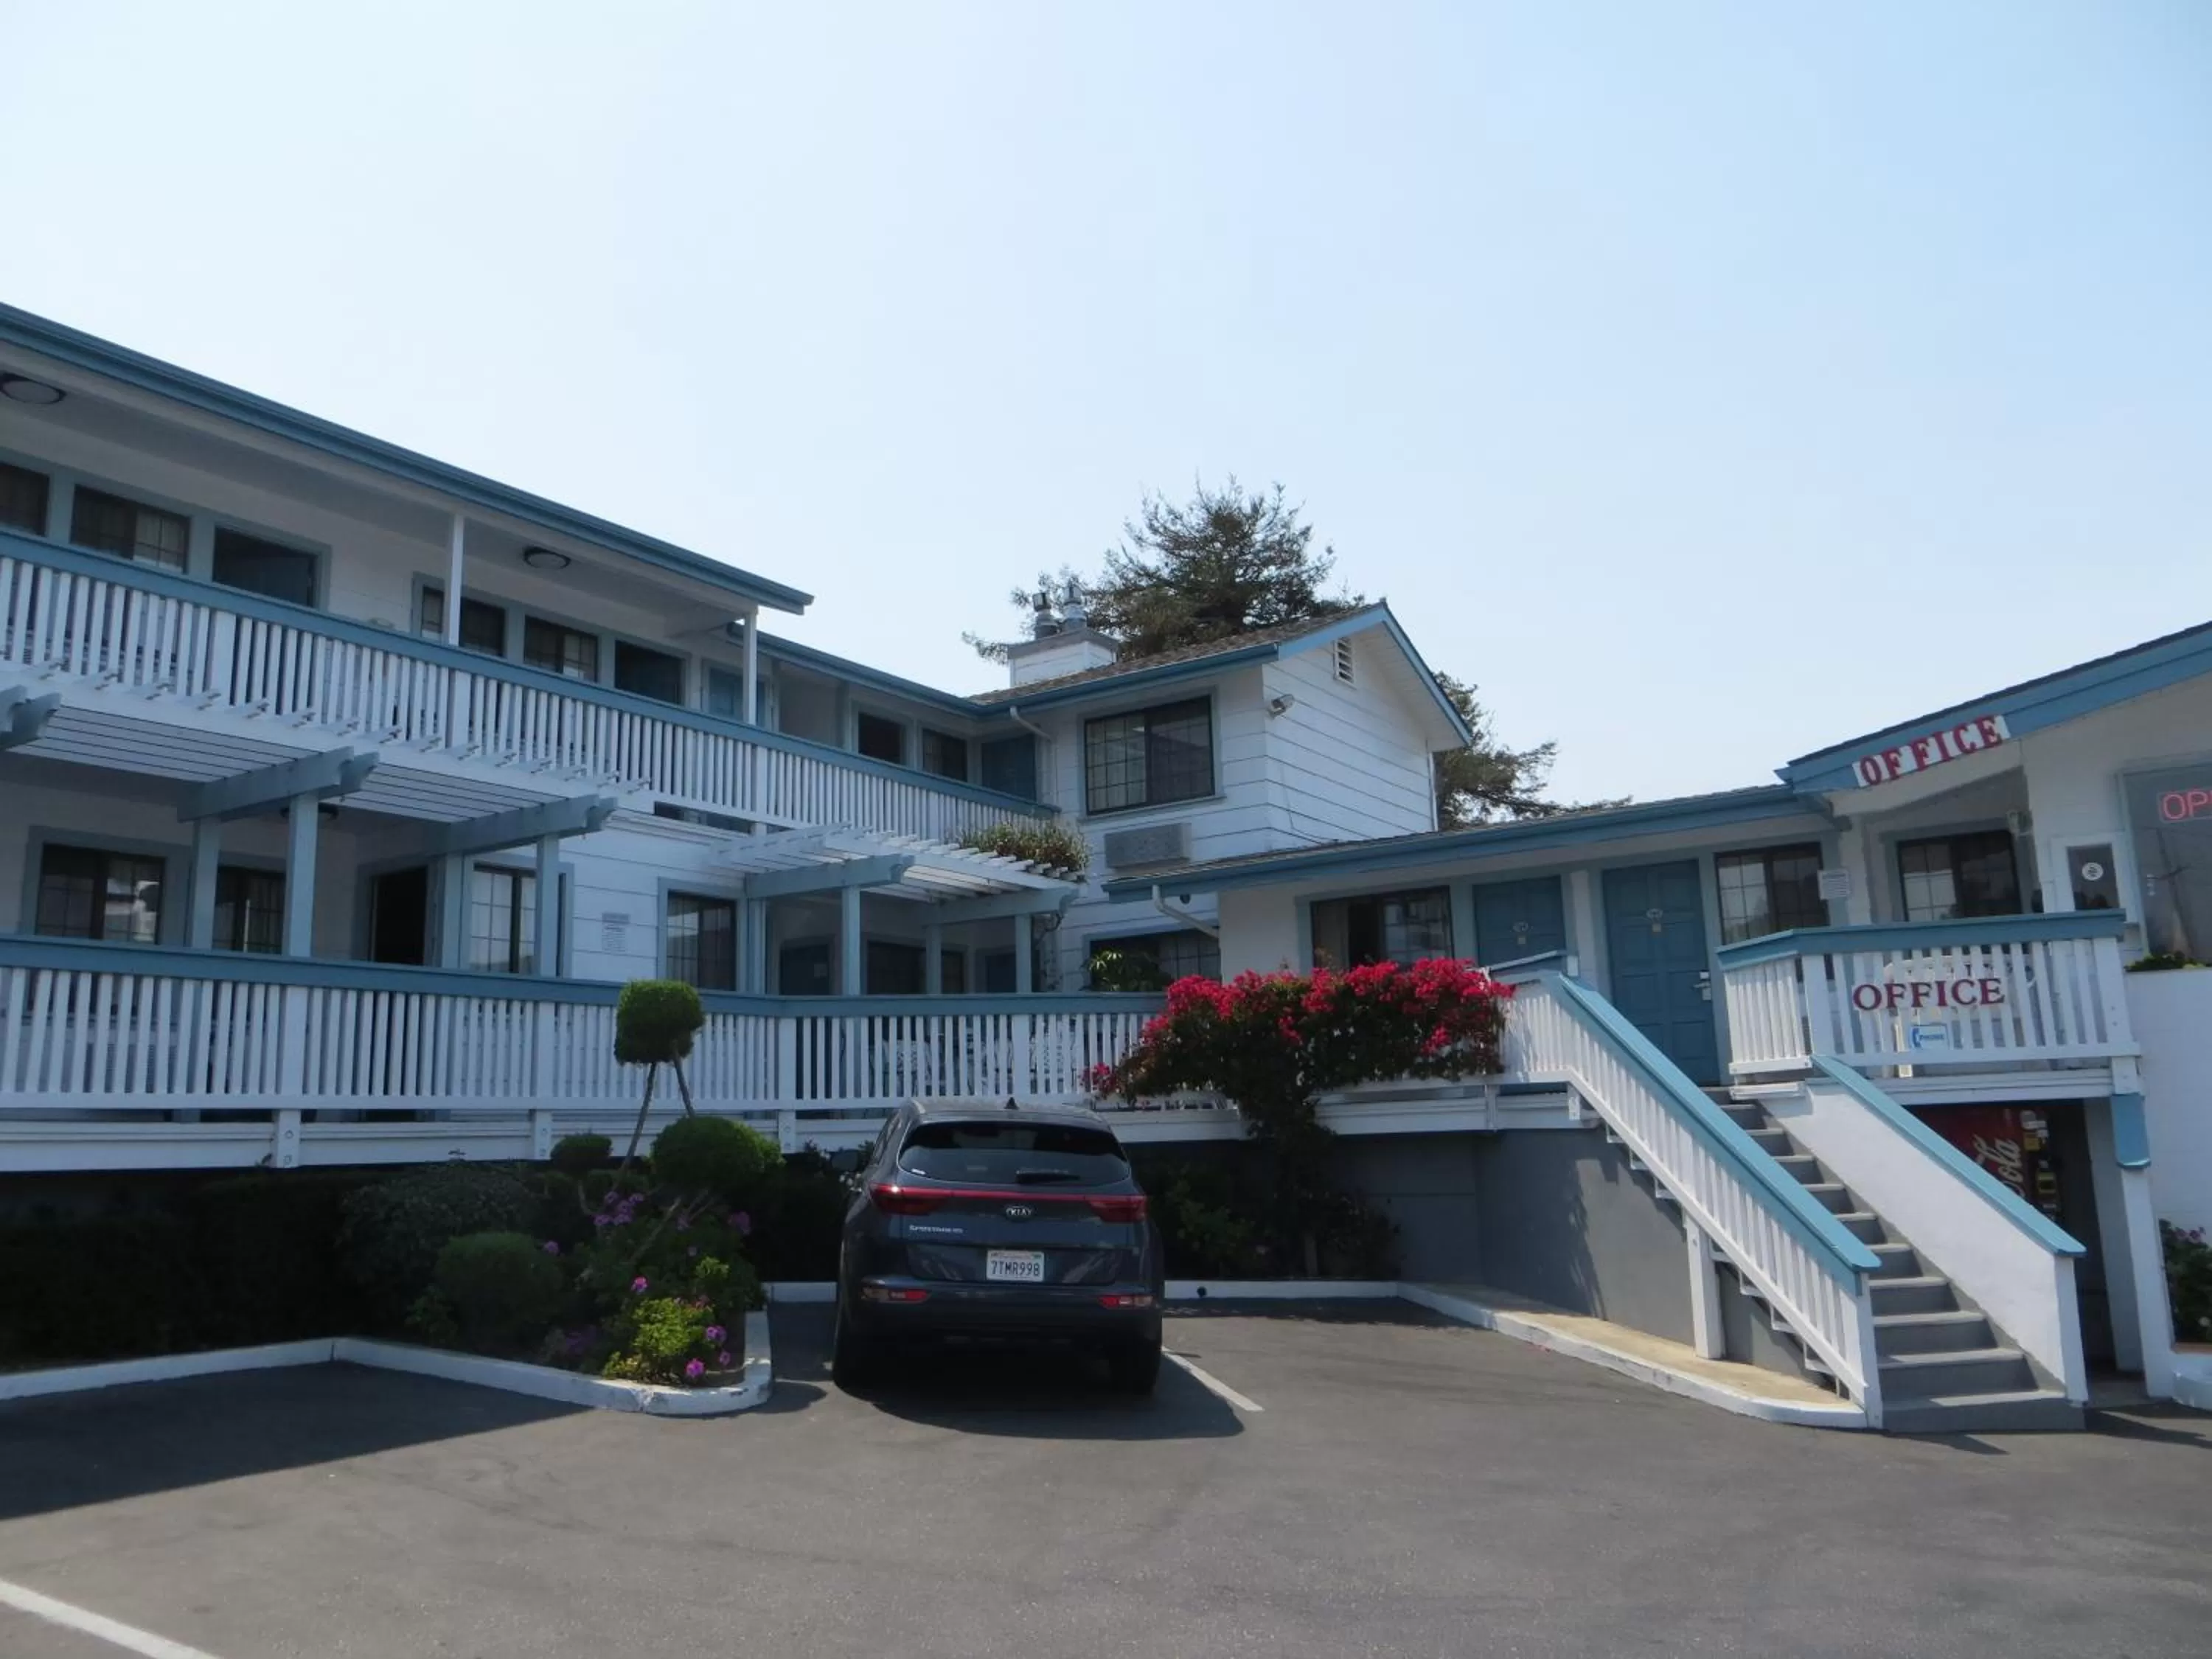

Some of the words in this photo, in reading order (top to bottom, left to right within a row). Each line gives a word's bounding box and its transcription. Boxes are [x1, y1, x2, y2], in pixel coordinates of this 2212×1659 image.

[1860, 714, 2003, 786] OFFICE
[2162, 790, 2212, 820] OP
[1852, 977, 2006, 1011] OFFICE
